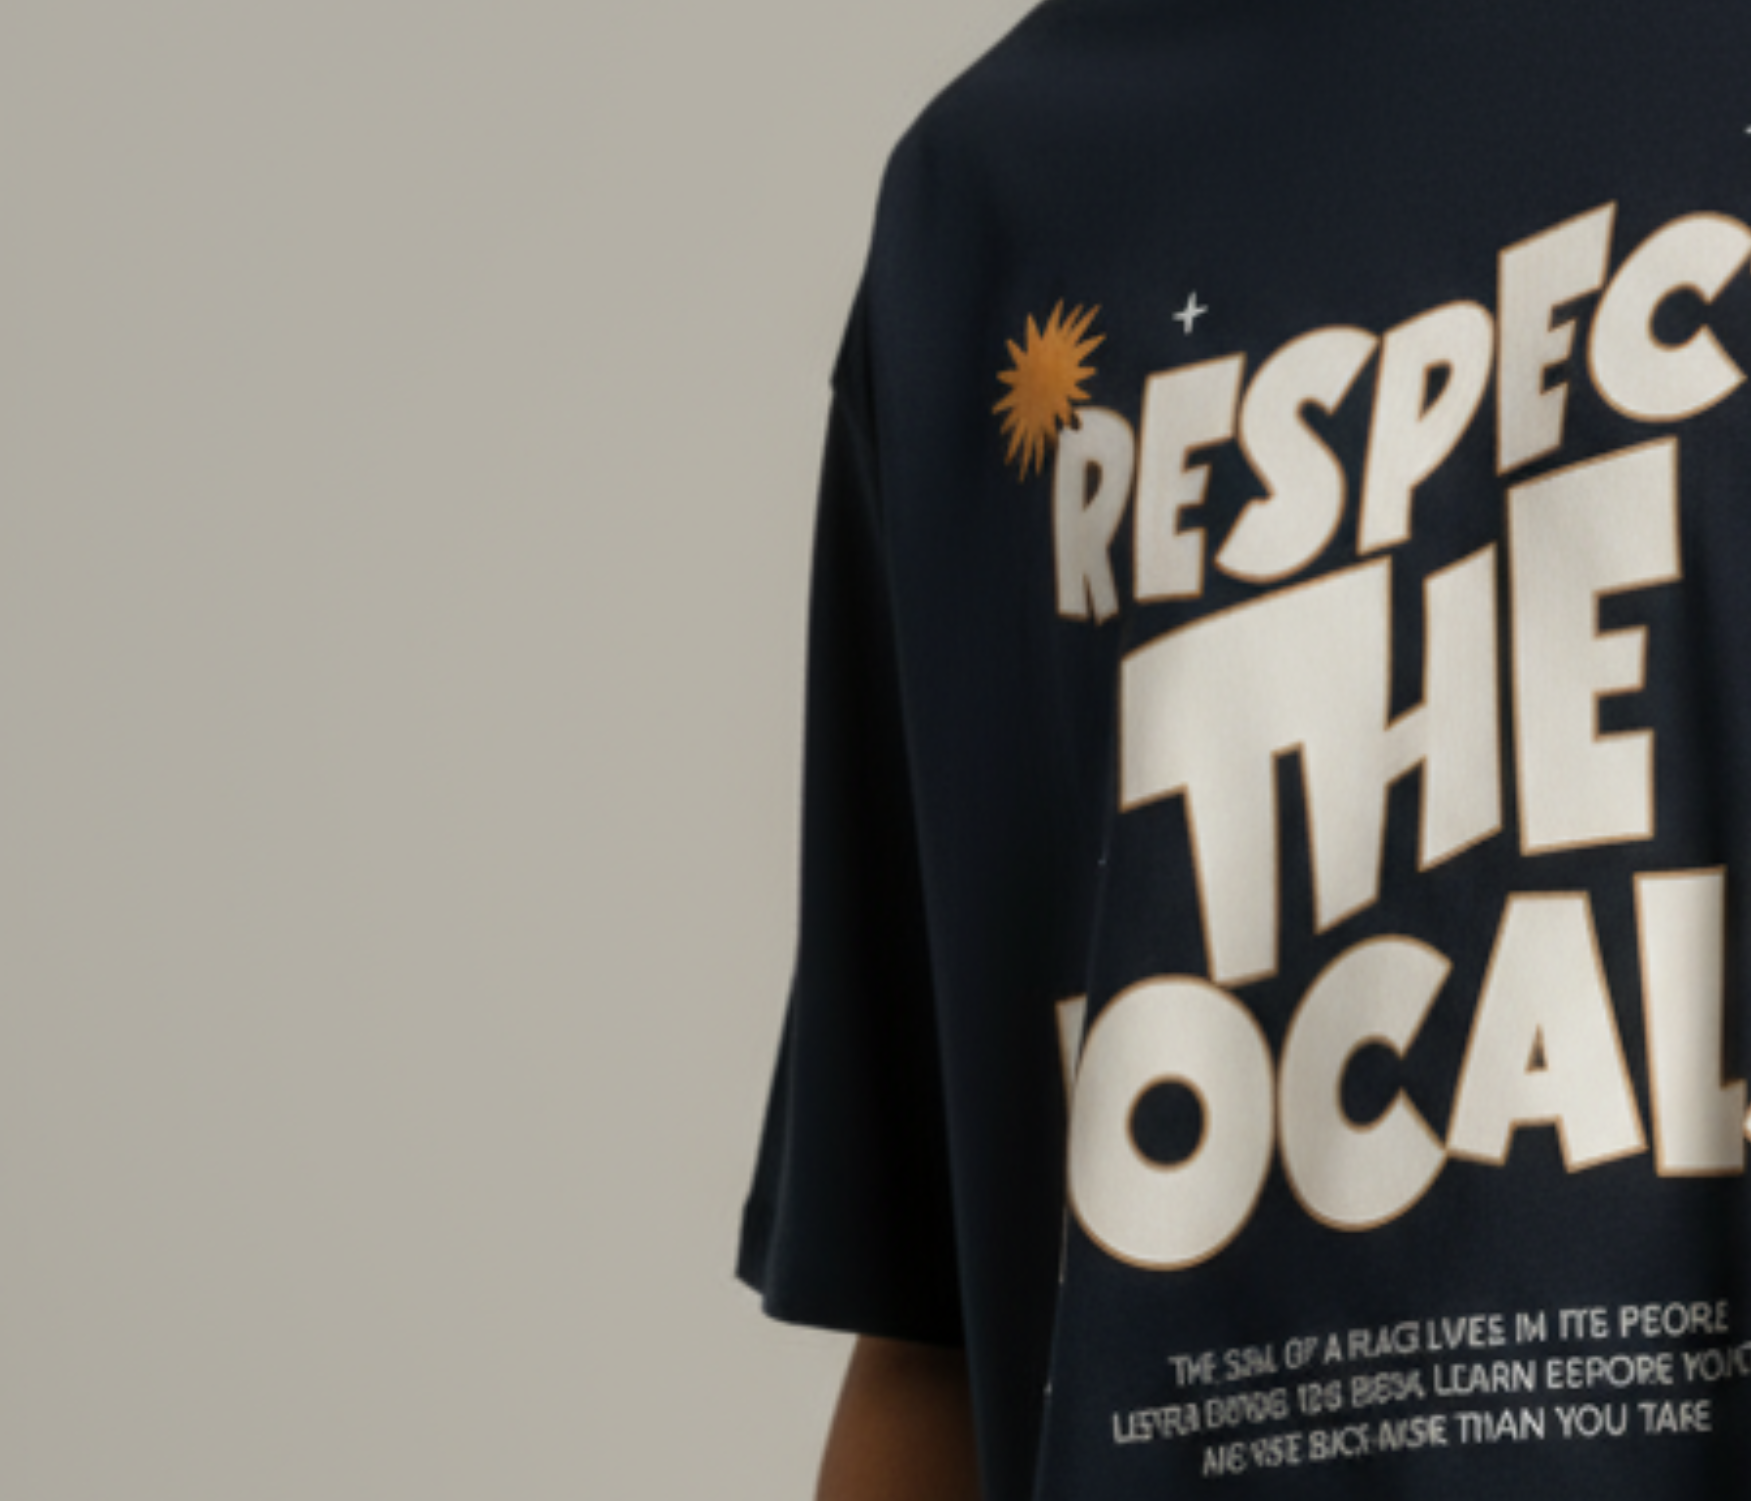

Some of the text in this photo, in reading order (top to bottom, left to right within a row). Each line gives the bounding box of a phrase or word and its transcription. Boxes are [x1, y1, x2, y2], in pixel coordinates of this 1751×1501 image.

[1119, 435, 1683, 986] THE
[1323, 1331, 1343, 1365] A
[1554, 1402, 1629, 1439] YOU
